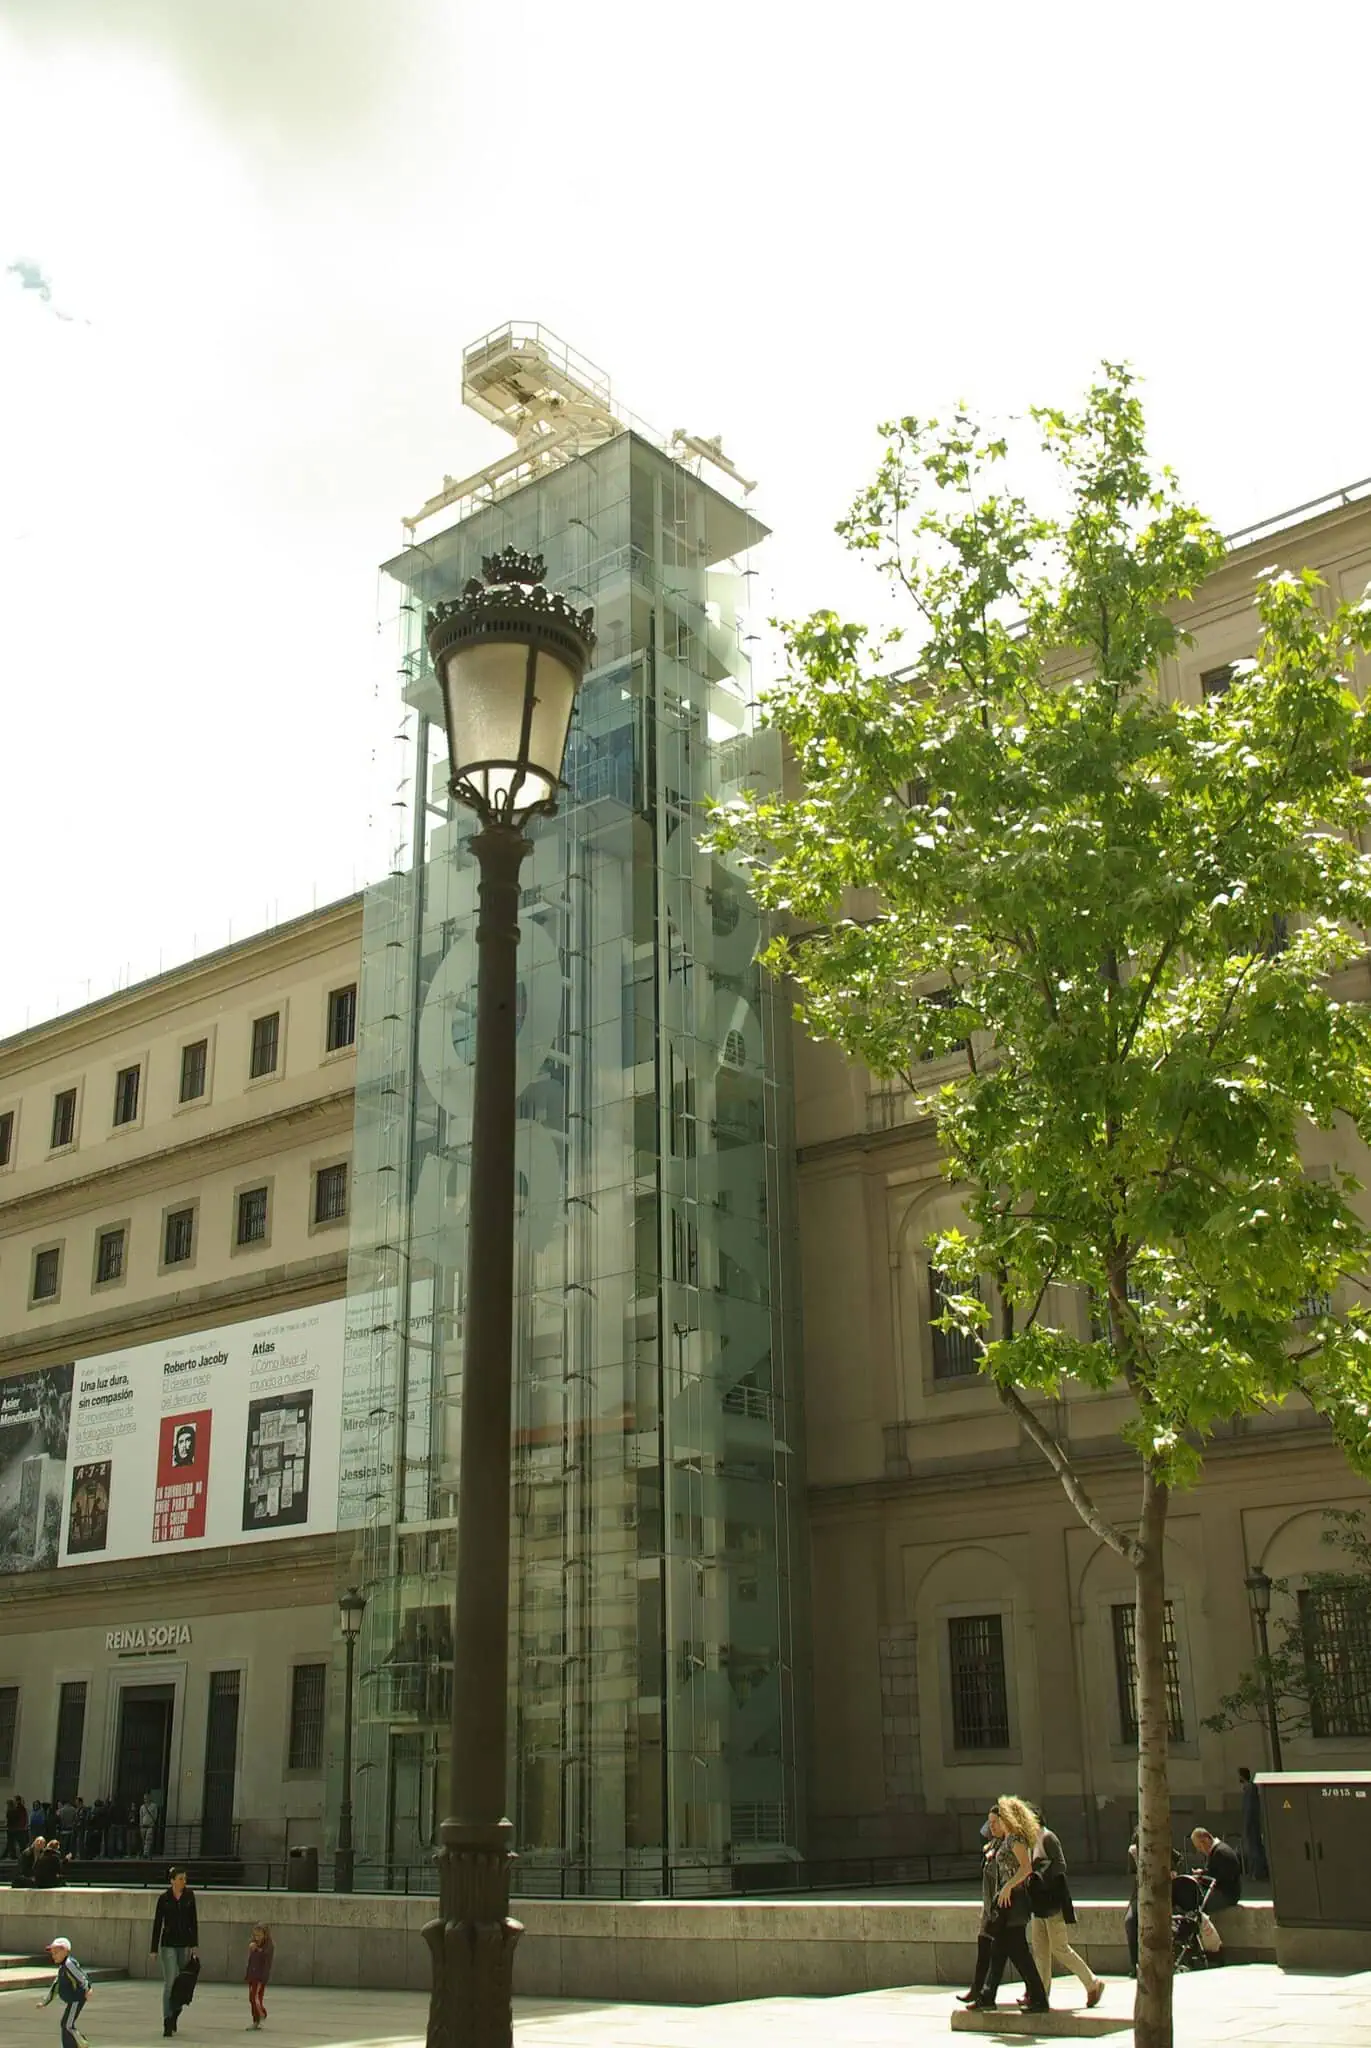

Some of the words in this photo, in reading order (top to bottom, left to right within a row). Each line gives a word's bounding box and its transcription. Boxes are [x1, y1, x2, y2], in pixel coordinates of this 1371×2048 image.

[252, 1341, 275, 1355] Atlas
[164, 1359, 197, 1375] Roberto
[198, 1350, 229, 1367] Jacoby
[81, 1381, 96, 1392] Una
[97, 1377, 108, 1389] luz
[110, 1374, 129, 1386] dura,
[79, 1397, 90, 1409] sin
[91, 1388, 133, 1406] compasión
[341, 1466, 377, 1481] Jessica
[105, 1628, 146, 1651] REINA
[147, 1624, 192, 1646] SOFIA
